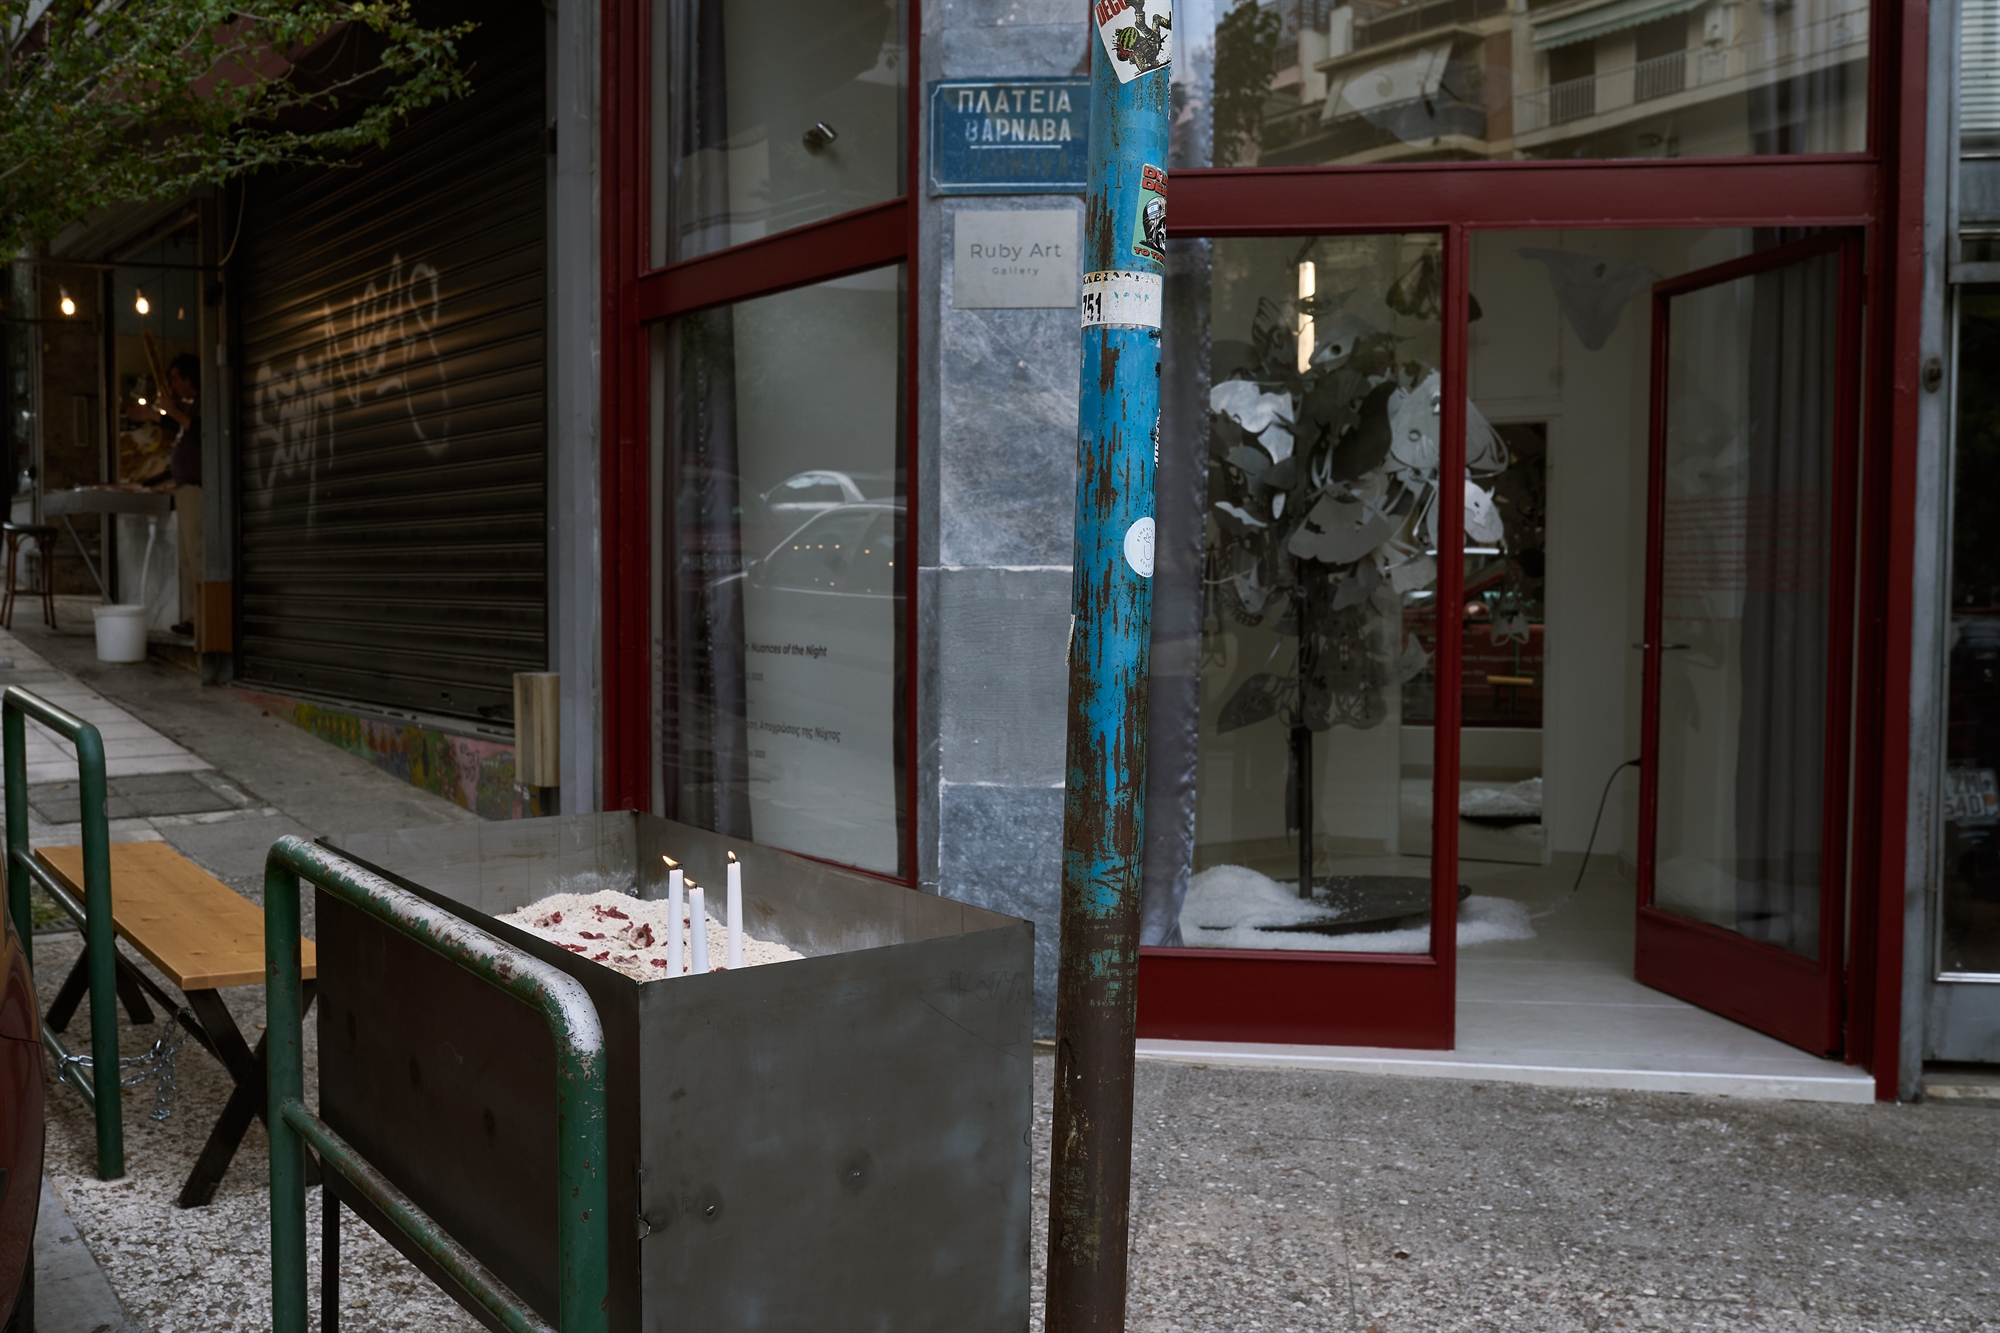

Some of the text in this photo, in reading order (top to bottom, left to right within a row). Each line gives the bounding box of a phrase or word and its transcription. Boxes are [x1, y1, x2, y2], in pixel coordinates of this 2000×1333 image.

[957, 89, 1072, 114] ΠΛΑΤΕΙΑ
[964, 118, 1072, 142] ΒΑΡΝΑΒΑ
[968, 151, 1070, 177] ARNAVA
[970, 243, 1062, 261] Ruby Art
[1133, 246, 1150, 257] TO
[991, 266, 1039, 276] Gallery
[751, 642, 782, 655] Nuances
[783, 643, 792, 655] of
[792, 644, 805, 656] the
[806, 645, 828, 660] Night
